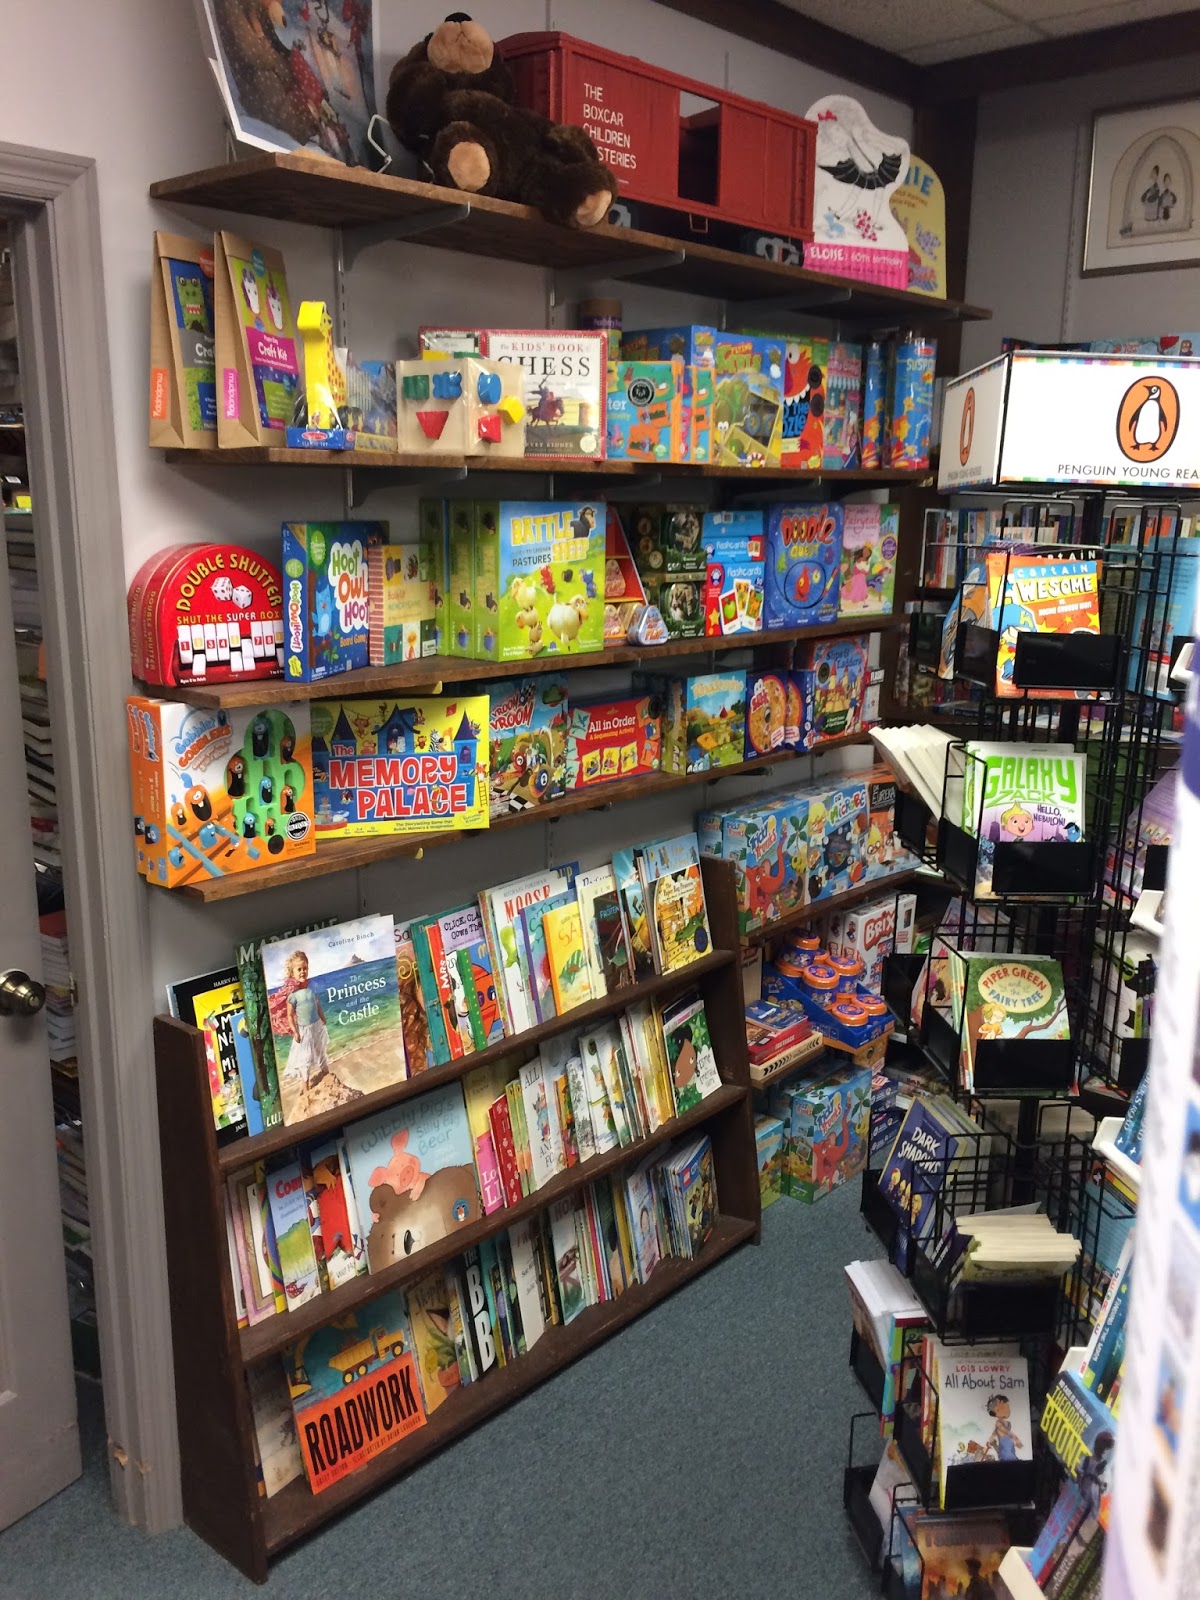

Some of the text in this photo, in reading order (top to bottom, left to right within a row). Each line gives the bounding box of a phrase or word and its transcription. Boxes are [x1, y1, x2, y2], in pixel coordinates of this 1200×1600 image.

[584, 83, 604, 102] THE
[583, 103, 625, 127] BOXCAR
[583, 123, 631, 149] CHILDREN
[598, 147, 637, 170] STERIES
[257, 341, 288, 361] Craft Kit
[549, 343, 584, 353] BOOK
[1057, 464, 1117, 477] PENGUIN
[1122, 466, 1171, 479] YOUNG
[511, 510, 574, 546] BATTLE
[551, 537, 589, 563] SHEEP
[716, 540, 748, 550] flashcards
[790, 544, 820, 560] QUEST
[332, 549, 360, 577] HOOT
[512, 554, 552, 567] PASTURES
[727, 565, 762, 577] flashcards
[175, 553, 282, 612] DOUBLE SHUTTER
[338, 569, 368, 604] OWL
[1003, 574, 1093, 606] AWESOME
[177, 610, 280, 625] SHUT THE SUPER BOX
[491, 691, 520, 718] VROOM
[489, 702, 535, 731] VROOM
[588, 715, 636, 733] All in Order
[333, 744, 356, 757] The
[329, 755, 458, 789] MEMORY
[984, 755, 1077, 804] GALAXY
[357, 785, 468, 819] PALACE
[998, 789, 1057, 804] ZACK
[1032, 812, 1066, 827] NEBULON!
[1036, 803, 1063, 816] HELLO,
[328, 931, 375, 948] Caroline Binch
[865, 910, 896, 946] BRIX
[326, 975, 387, 1003] Princess
[349, 974, 362, 983] The
[982, 966, 1048, 991] PIPER GREEN
[345, 995, 370, 1008] and the
[988, 989, 1045, 1008] FAIRY TREE
[338, 1003, 380, 1026] Castle
[911, 1126, 941, 1156] DARK
[899, 1139, 942, 1174] SHADOWS
[955, 1365, 1010, 1373] LOIS LOWRY
[945, 1373, 1025, 1390] All About Sam
[305, 1365, 419, 1476] ROADWORK
[1052, 1385, 1088, 1434] THEODORE
[1040, 1392, 1093, 1479] BOONE
